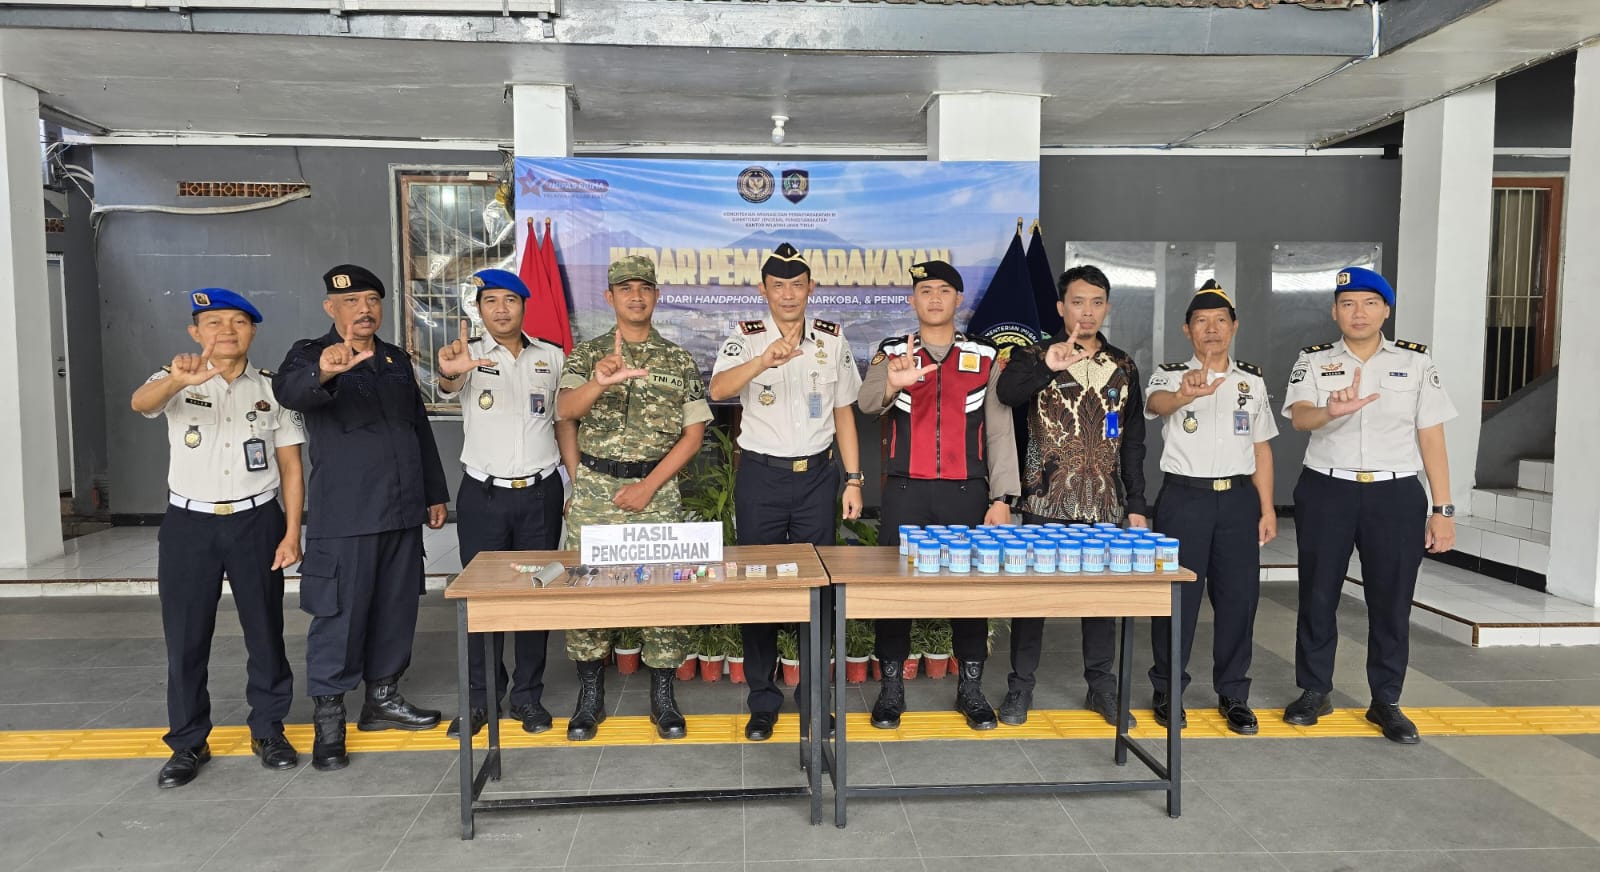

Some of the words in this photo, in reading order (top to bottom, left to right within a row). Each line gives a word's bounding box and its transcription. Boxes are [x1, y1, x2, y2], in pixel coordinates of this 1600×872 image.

[667, 295, 692, 304] DARI
[695, 295, 764, 304] HANDPHONE
[807, 296, 862, 305] NARKOBA,
[865, 296, 871, 304] &
[874, 296, 911, 304] PENIPU
[984, 325, 1020, 337] MENTERIAN
[653, 375, 668, 383] TNI
[671, 378, 683, 386] AD
[623, 526, 678, 542] HASIL
[591, 542, 709, 562] PENGGELEDAHAN
